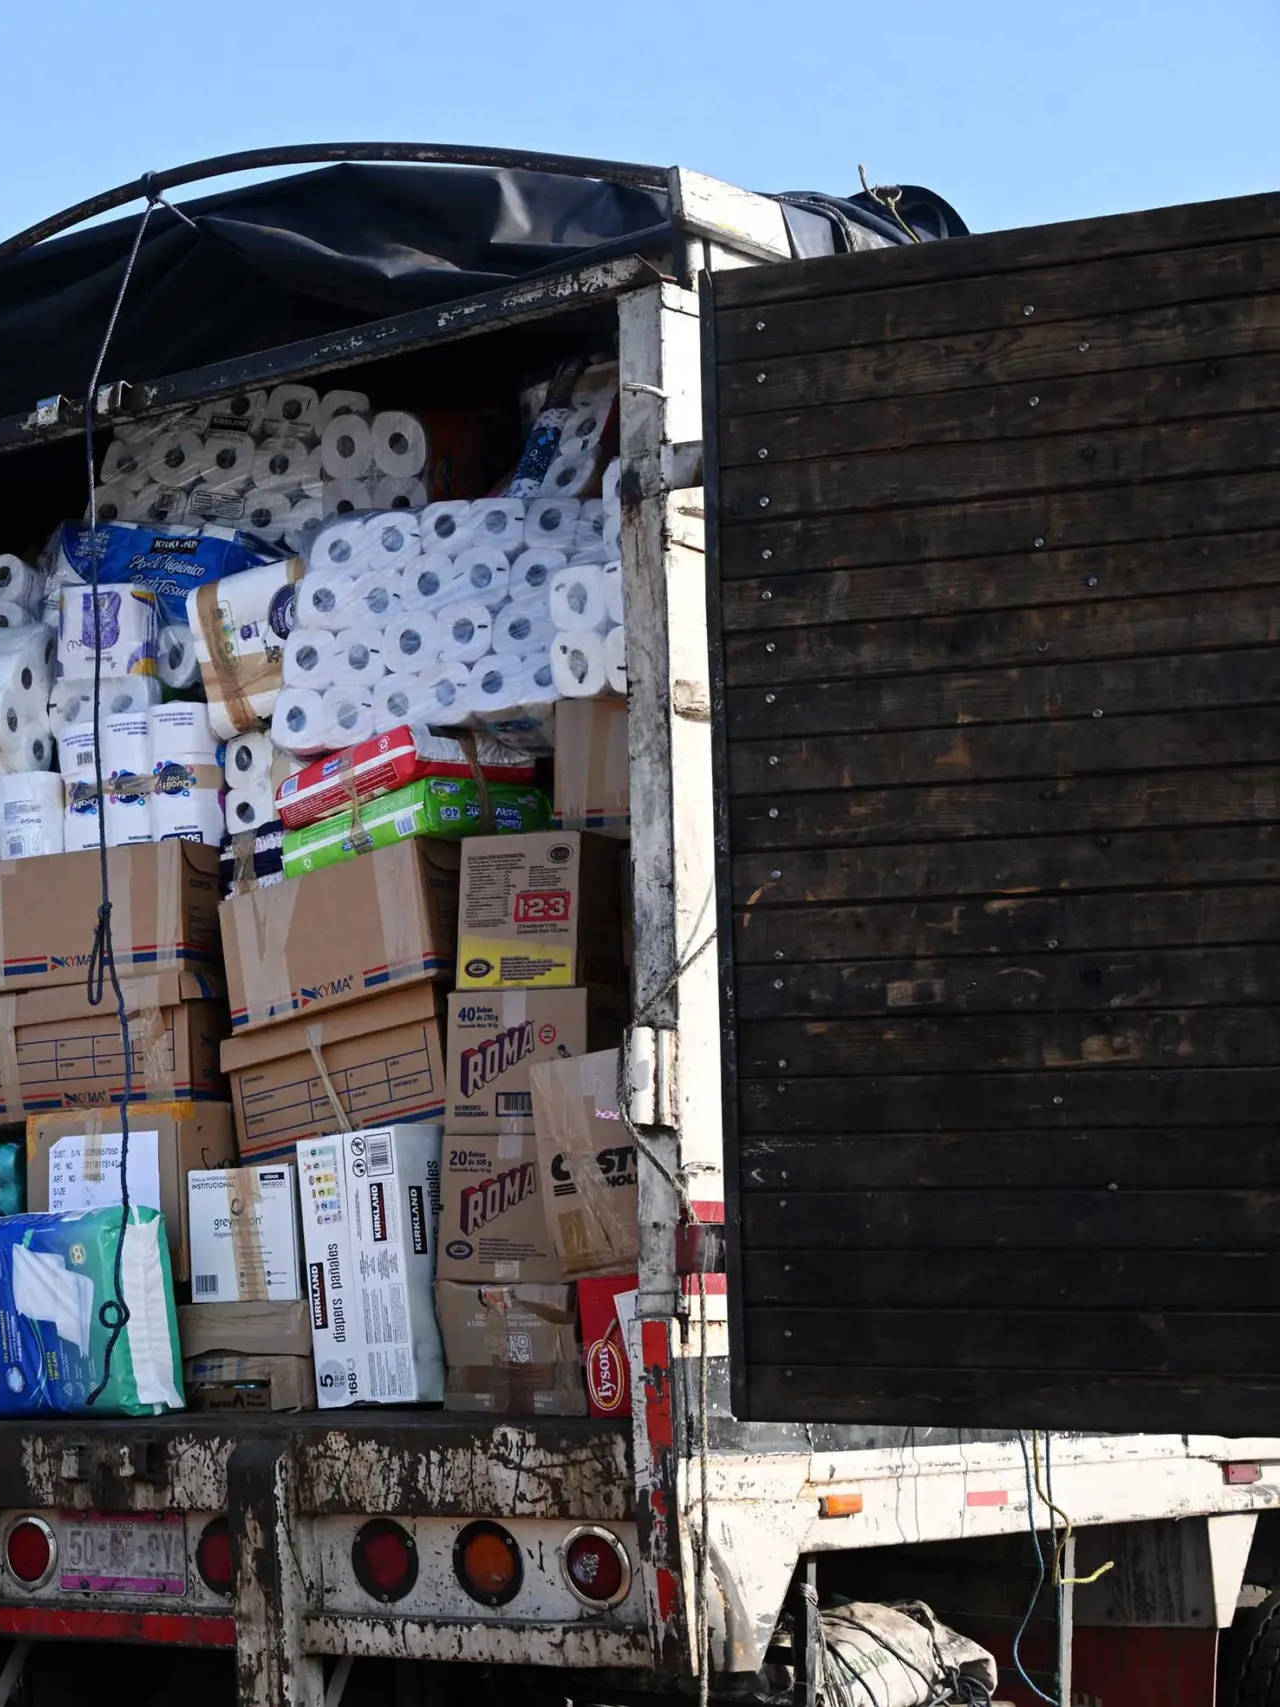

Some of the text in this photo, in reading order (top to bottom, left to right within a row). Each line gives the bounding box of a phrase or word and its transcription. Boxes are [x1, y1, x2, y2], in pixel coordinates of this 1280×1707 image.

[154, 540, 199, 550] KIRKND
[65, 954, 94, 968] KYMA
[314, 974, 354, 1000] KYMA
[458, 1006, 475, 1022] 40
[460, 1020, 536, 1098] ROMA
[449, 1150, 468, 1166] 20
[191, 1181, 236, 1190] INSTITUCIONAL
[460, 1161, 538, 1237] ROMA
[213, 1216, 261, 1231] greymon
[370, 1185, 383, 1240] KIRKLAND
[409, 1188, 423, 1251] KIRKLAND
[328, 1243, 344, 1290] pañales
[310, 1265, 323, 1327] KIRKLAND
[332, 1298, 347, 1343] diapers
[320, 1373, 334, 1388] 5
[347, 1372, 359, 1396] 168
[596, 1346, 618, 1399] Tyson
